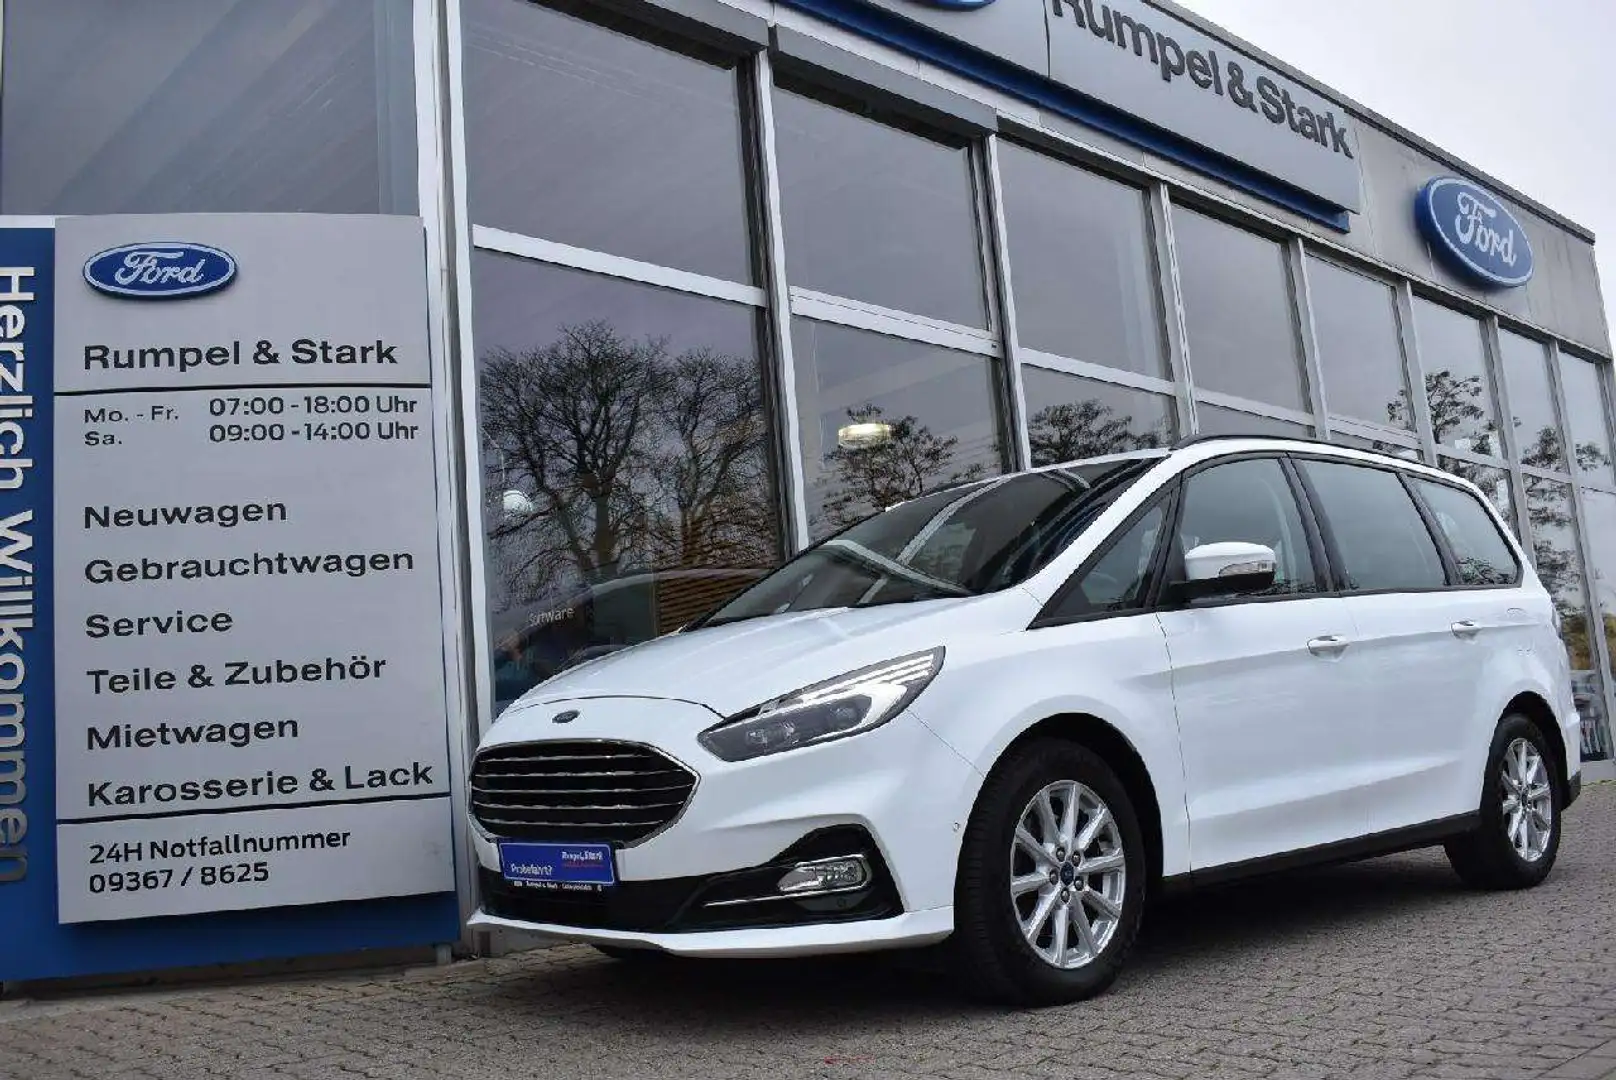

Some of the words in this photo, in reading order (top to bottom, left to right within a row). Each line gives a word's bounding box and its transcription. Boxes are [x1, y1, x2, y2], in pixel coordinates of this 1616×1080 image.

[1227, 62, 1257, 113] &
[1257, 75, 1354, 159] Stark
[1455, 191, 1517, 268] Ford
[115, 251, 204, 285] Ford
[85, 341, 239, 372] Rumpel
[253, 340, 280, 364] &
[292, 339, 397, 364] Stark
[0, 266, 35, 489] Herzlich
[85, 409, 128, 423] Mo.
[152, 406, 178, 420] Fr.
[210, 397, 283, 416] 07:00
[377, 396, 417, 413] Uhr
[85, 431, 122, 445] Sa.
[210, 424, 284, 442] 09:00
[378, 422, 418, 439] Uhr
[85, 503, 286, 528] Neuwagen
[85, 553, 412, 584] Gebrauchtwagen
[86, 611, 232, 638] Service
[87, 668, 176, 694] Teile
[188, 665, 214, 688] &
[225, 656, 386, 685] Zubehör
[0, 509, 33, 882] Willkommen
[88, 720, 297, 750] Mietwagen
[88, 770, 299, 807] Karosserie
[310, 769, 335, 791] &
[345, 762, 432, 789] Lack
[90, 843, 142, 863] 24H
[150, 832, 350, 859] Notfallnummer
[90, 869, 172, 893] 09367
[181, 867, 193, 886] /
[201, 862, 268, 885] 8625
